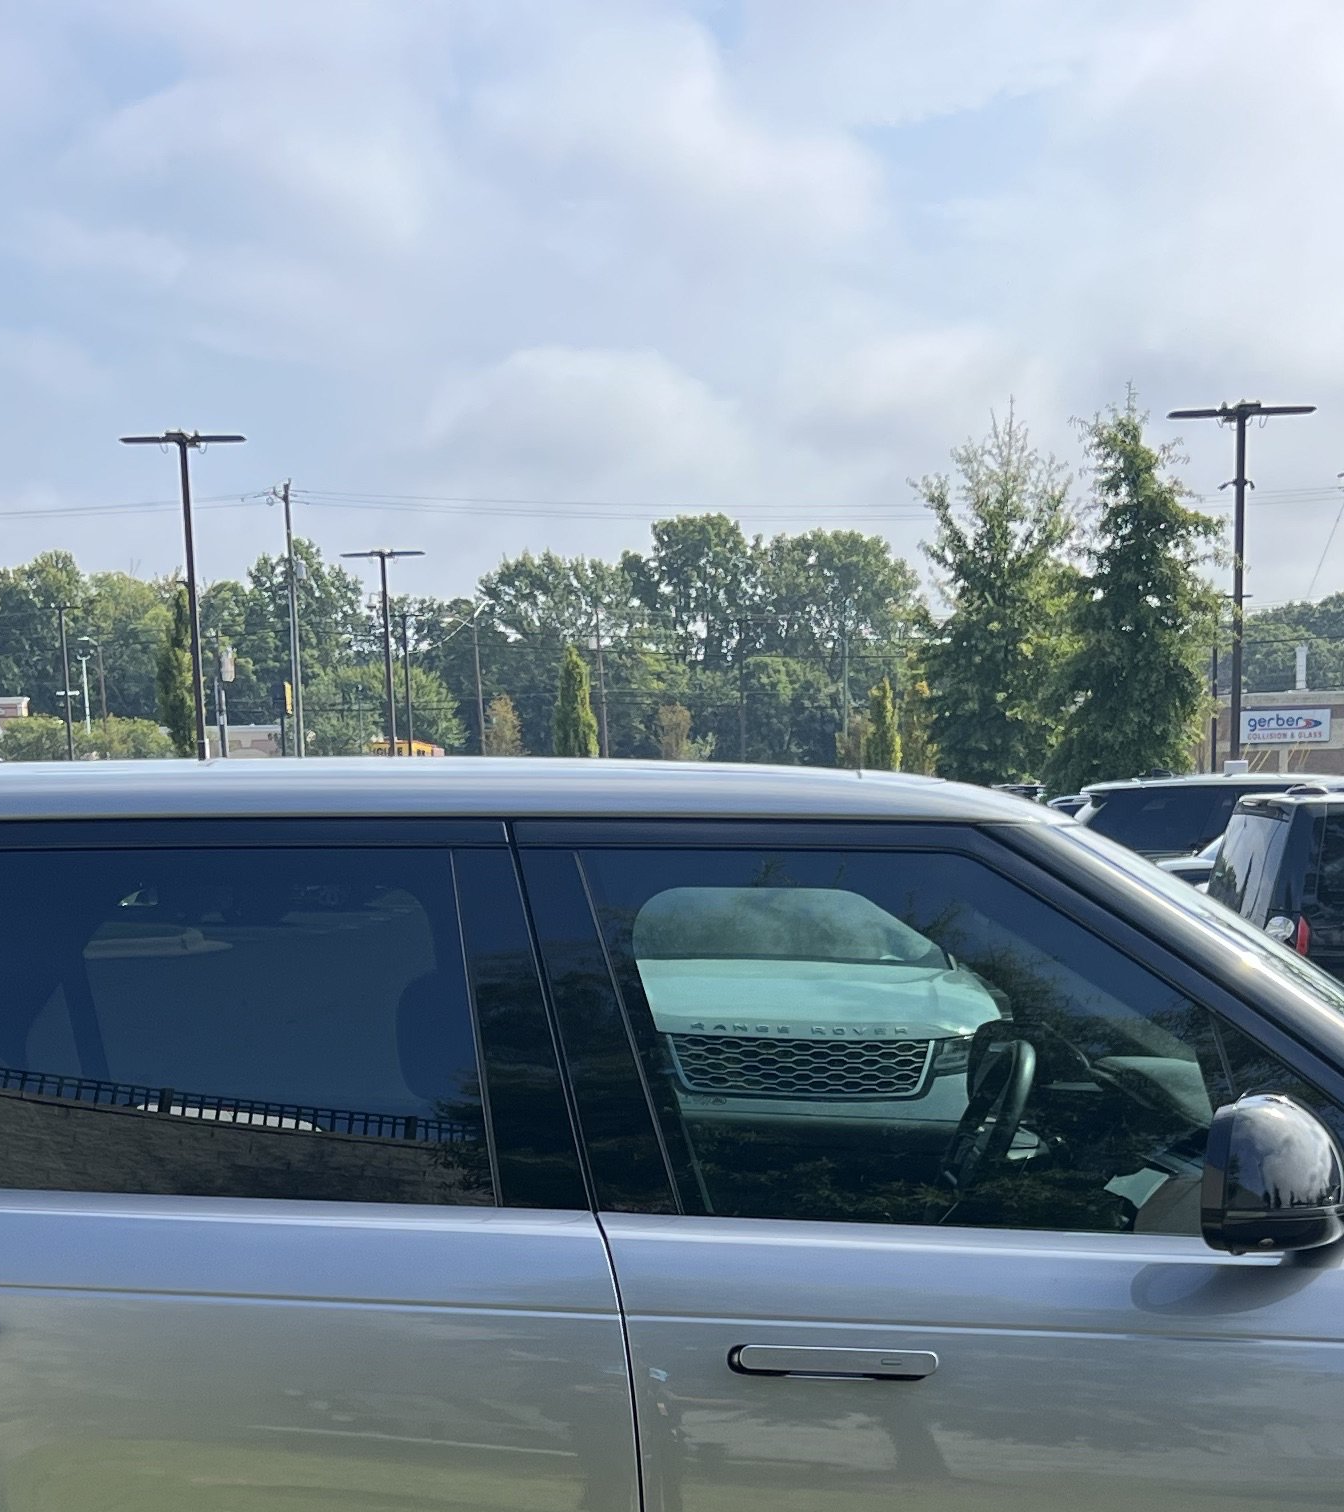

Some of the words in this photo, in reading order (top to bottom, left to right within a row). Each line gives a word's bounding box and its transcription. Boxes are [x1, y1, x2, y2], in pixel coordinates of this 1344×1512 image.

[1248, 714, 1303, 732] gerber
[1247, 732, 1287, 741] COLLISION
[1290, 732, 1295, 740] &
[1298, 731, 1323, 739] GLASS
[690, 1022, 791, 1034] RANGE
[811, 1025, 909, 1036] ROVER
